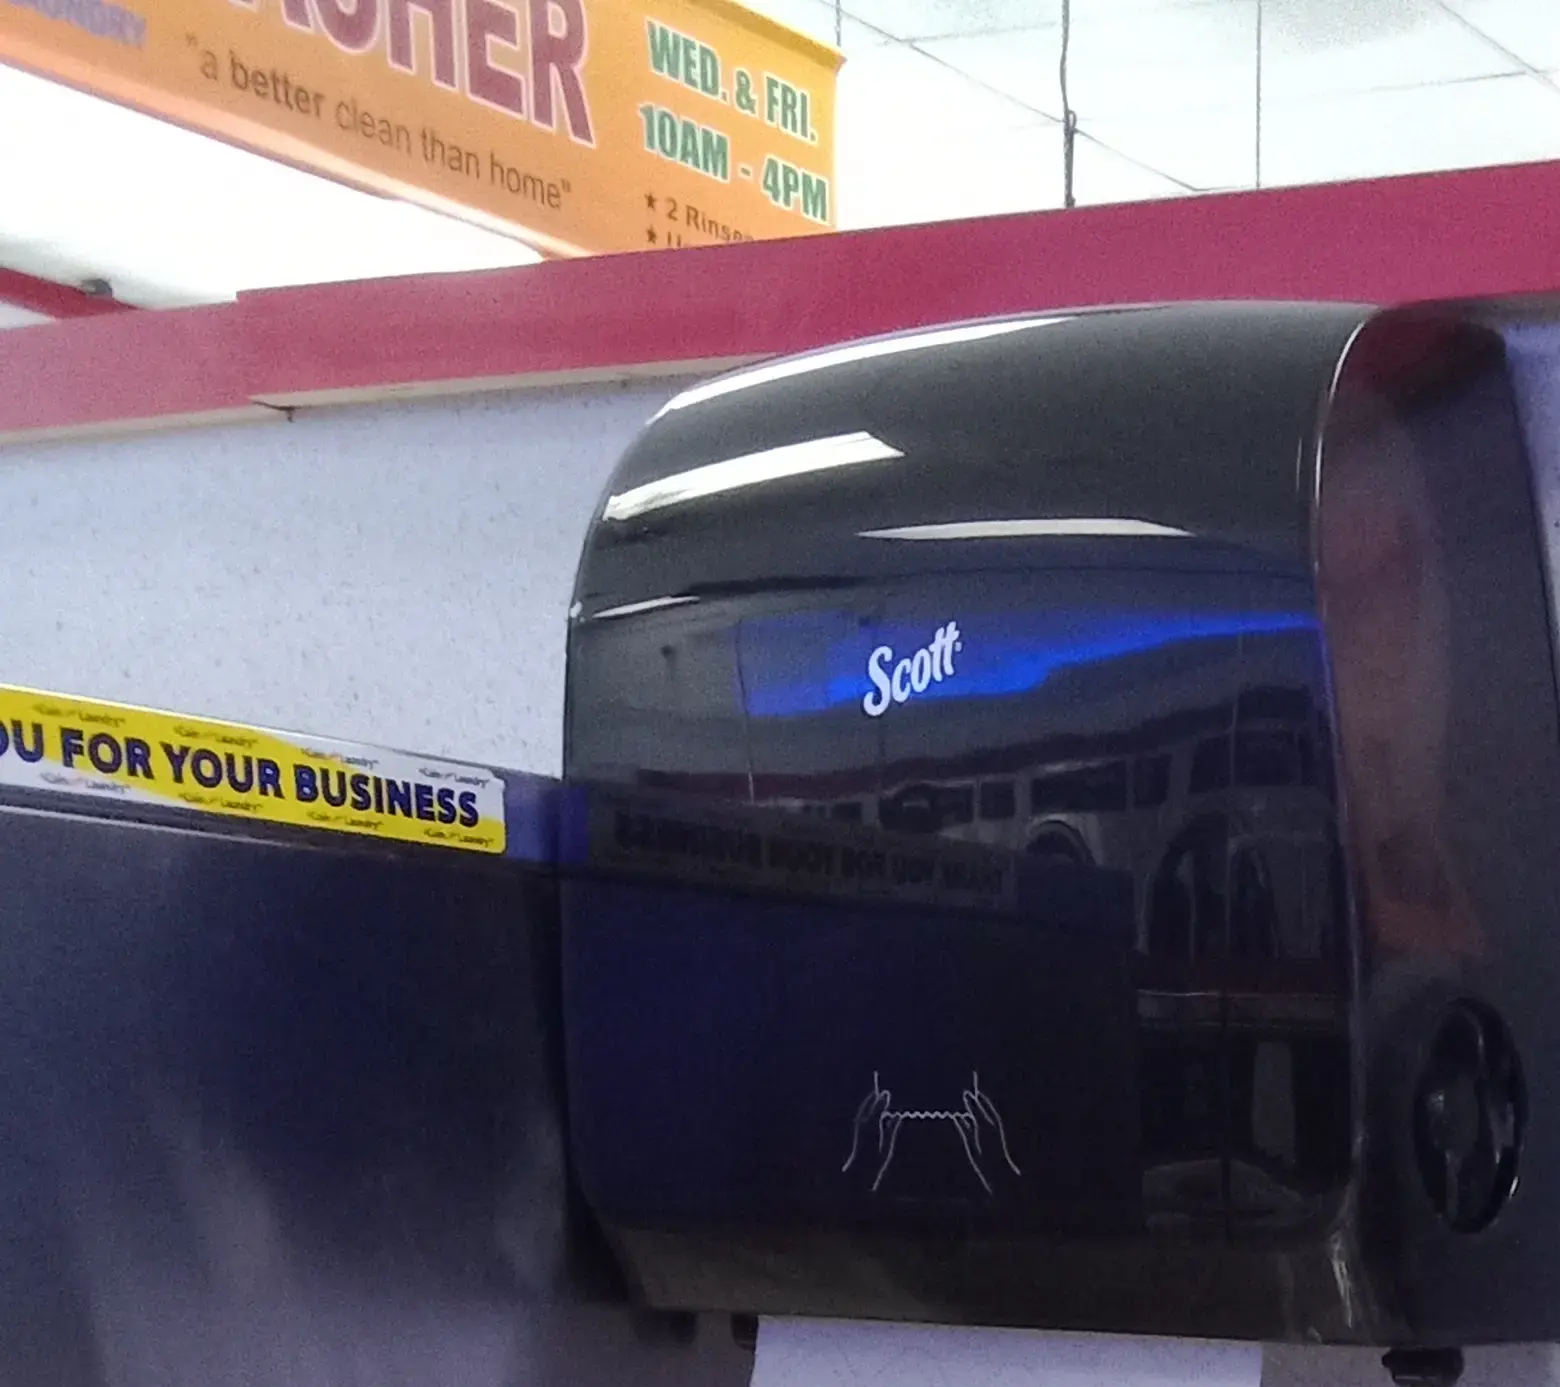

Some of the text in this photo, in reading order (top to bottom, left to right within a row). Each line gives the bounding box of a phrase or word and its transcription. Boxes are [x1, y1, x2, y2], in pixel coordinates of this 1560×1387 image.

[229, 49, 327, 119] better
[335, 97, 412, 155] clean
[420, 123, 480, 180] than
[646, 18, 817, 143] WED. & FRI.
[639, 103, 729, 182] 10AM
[761, 156, 829, 222] 4PM
[665, 197, 679, 222] 2
[863, 620, 962, 717] Scott
[0, 720, 45, 763] U
[60, 726, 155, 780] FOR
[159, 740, 285, 799] YOUR
[293, 763, 479, 828] BUSINESS
